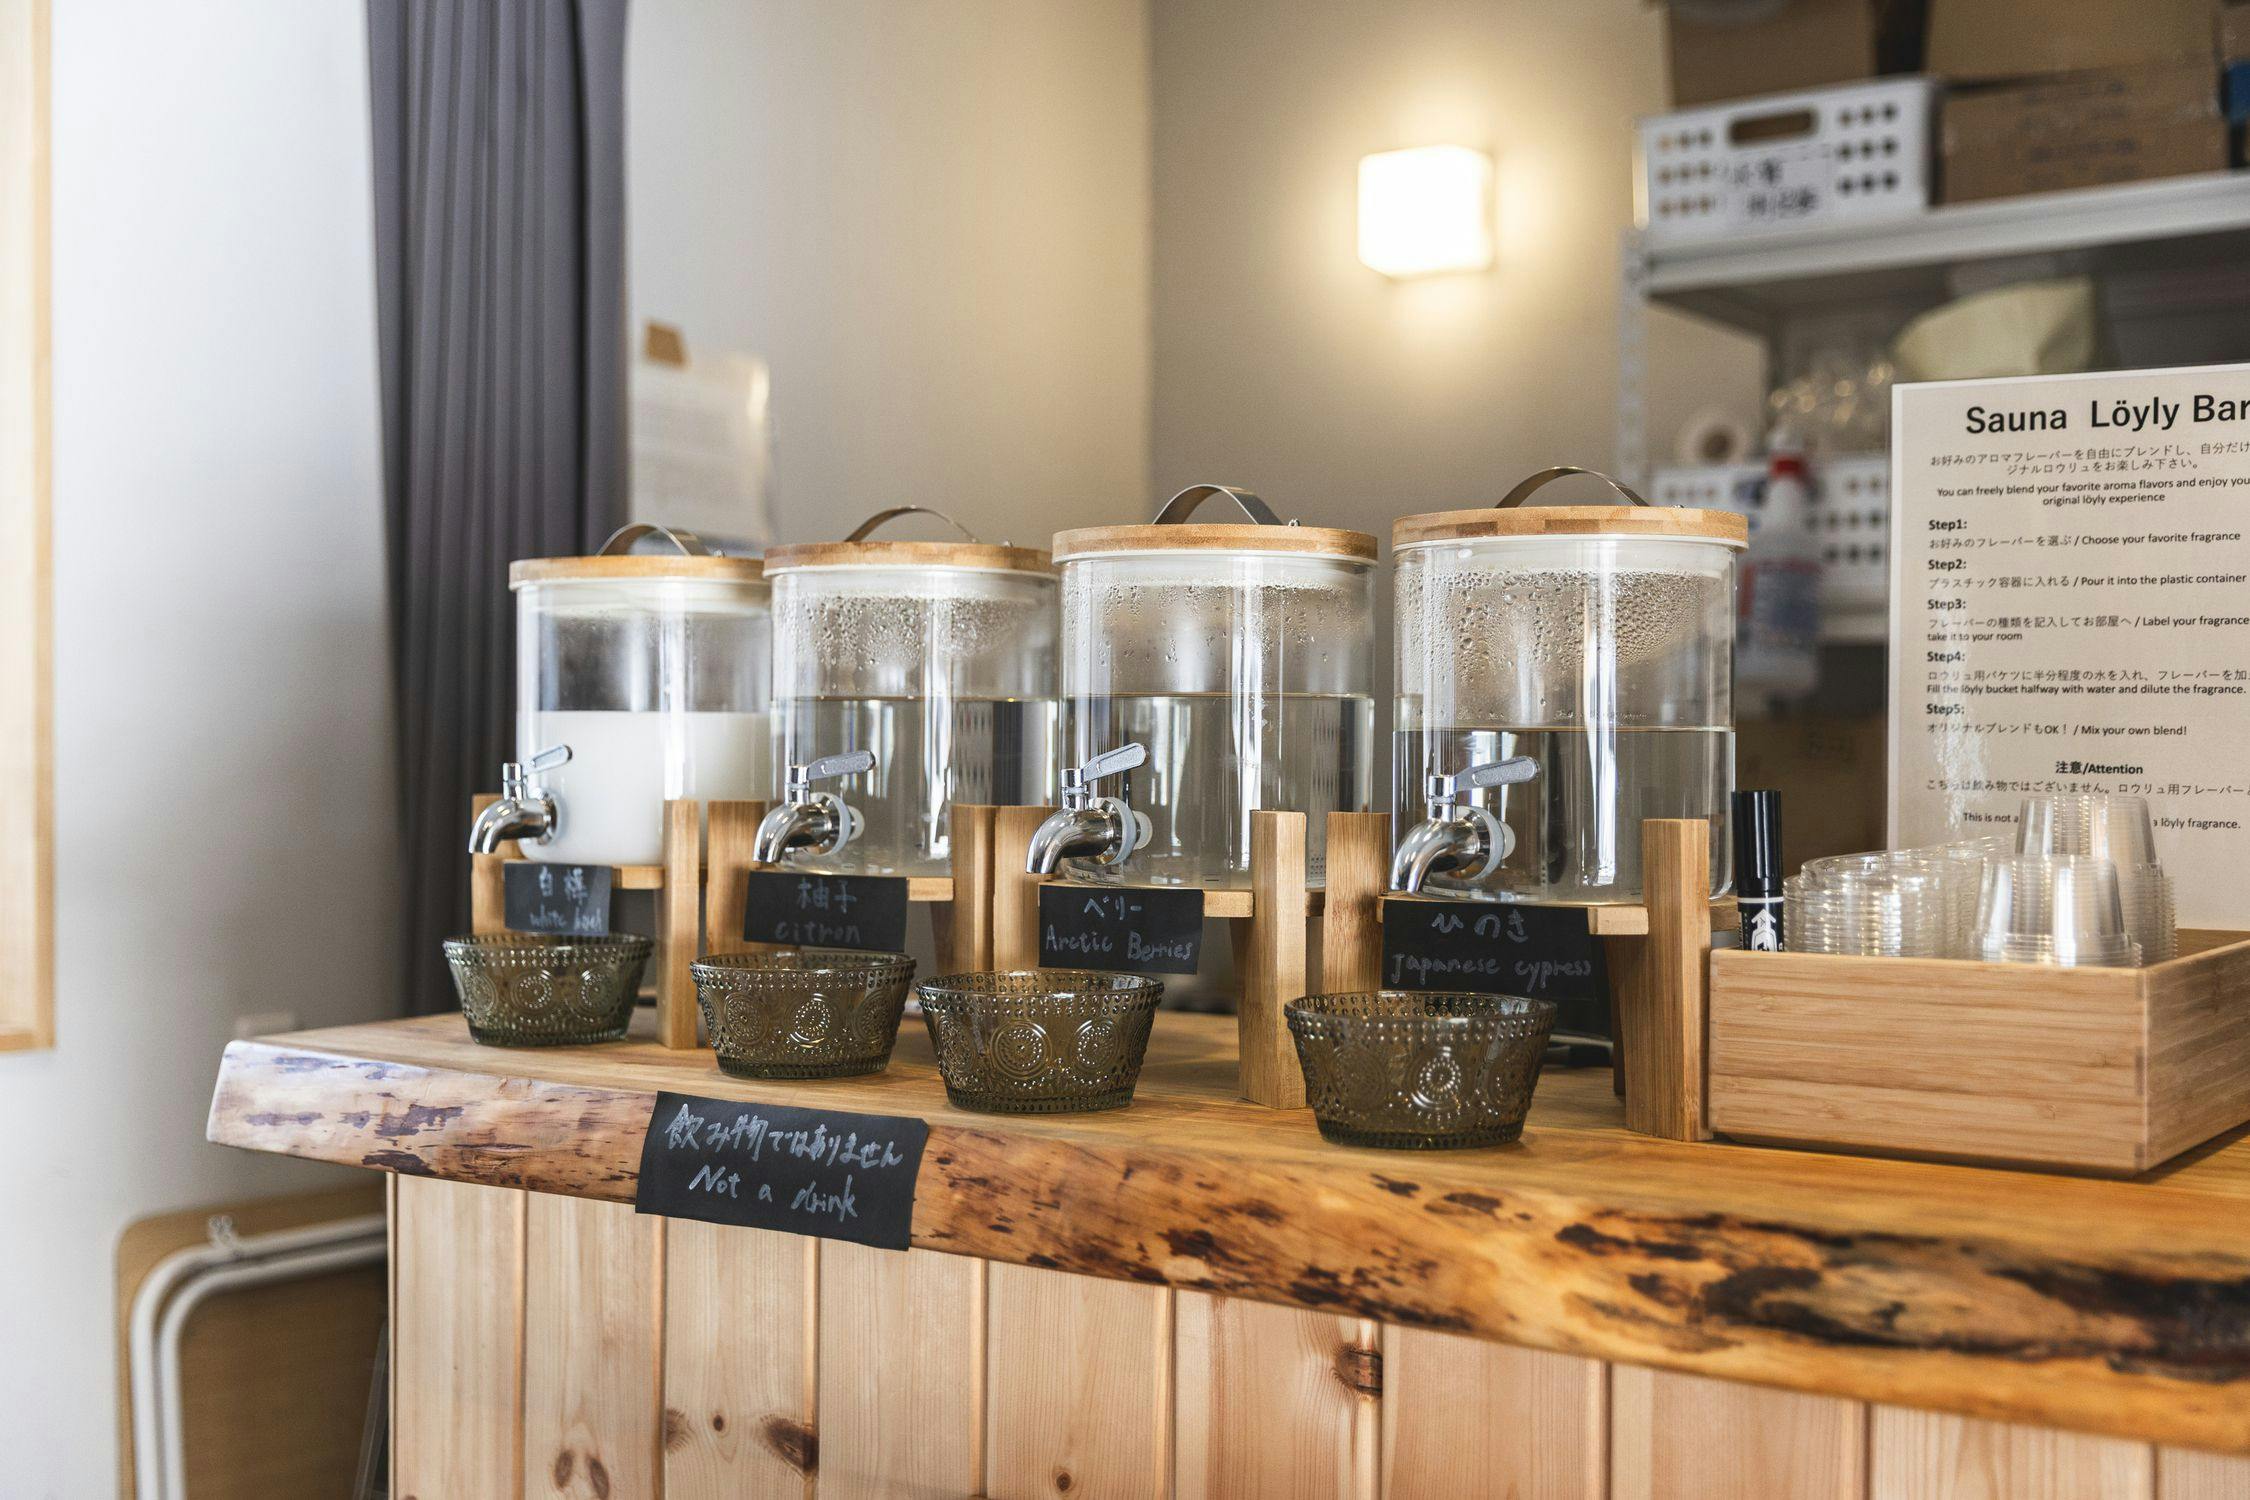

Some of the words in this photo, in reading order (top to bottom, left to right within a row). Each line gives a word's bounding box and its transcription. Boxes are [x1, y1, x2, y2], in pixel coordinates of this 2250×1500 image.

[1966, 405, 2067, 434] Sauna
[2091, 396, 2180, 432] Löyly
[2193, 394, 2250, 423] Bar
[1937, 487, 1954, 497] You
[1956, 488, 1974, 497] can
[1976, 485, 2004, 496] freely
[2006, 484, 2035, 494] blend
[2037, 485, 2060, 495] your
[2062, 482, 2101, 493] favorite
[2103, 481, 2136, 490] aroma
[2139, 479, 2174, 489] flavors
[2176, 477, 2196, 487] and
[2198, 477, 2228, 488] enjoy
[2042, 495, 2080, 507] original
[2082, 495, 2106, 506] löyly
[2108, 493, 2166, 505] experience
[1928, 519, 1968, 532] Step1:
[2081, 535, 2119, 545] Choose
[2122, 535, 2146, 546] your
[2148, 533, 2188, 543] favorite
[2191, 532, 2241, 544] fragrance
[1928, 558, 1967, 571] Step2:
[2081, 576, 2105, 586] Pour
[2107, 575, 2114, 585] it
[2117, 575, 2138, 585] into
[2140, 575, 2158, 585] the
[2160, 573, 2194, 586] plastic
[2196, 573, 2247, 584] container
[1927, 598, 1967, 611] Step3:
[2142, 616, 2170, 626] Label
[2173, 617, 2197, 628] your
[2199, 615, 2250, 627] fragrance
[1927, 632, 1947, 641] take
[1972, 633, 1994, 643] your
[1996, 632, 2023, 641] room
[1926, 651, 1966, 664] Step4:
[1928, 669, 2250, 682] ロウリュ用バケツに半分程度の水を入れ、フレーバーを加
[1926, 684, 1940, 694] Fill
[1942, 684, 1959, 694] the
[1961, 684, 1983, 695] löyly
[1986, 684, 2018, 694] bucket
[2021, 684, 2059, 695] halfway
[2061, 684, 2084, 694] with
[2087, 685, 2116, 694] water
[2118, 684, 2138, 694] and
[2140, 684, 2170, 694] dilute
[2173, 684, 2190, 694] the
[2193, 684, 2246, 696] fragrance.
[1926, 703, 1965, 716] Step5:
[2081, 725, 2100, 735] Mix
[2102, 726, 2125, 737] your
[2128, 727, 2151, 736] own
[2153, 725, 2188, 736] blend!
[1963, 812, 1983, 822] This
[1984, 813, 1992, 822] is
[1994, 813, 2010, 824] not
[2013, 815, 2019, 823] a
[2161, 818, 2185, 829] löyly
[2187, 818, 2241, 830] fragrance.
[1083, 895, 1143, 921] ベリー
[1431, 908, 1528, 943] ひのき
[1045, 924, 1113, 953] Arctic
[1127, 930, 1193, 962] Berries
[1514, 958, 1592, 993] cypress
[664, 1102, 904, 1170] 飲み物ではありません
[688, 1164, 741, 1199] Not
[758, 1183, 773, 1203] a
[790, 1173, 859, 1223] drink
